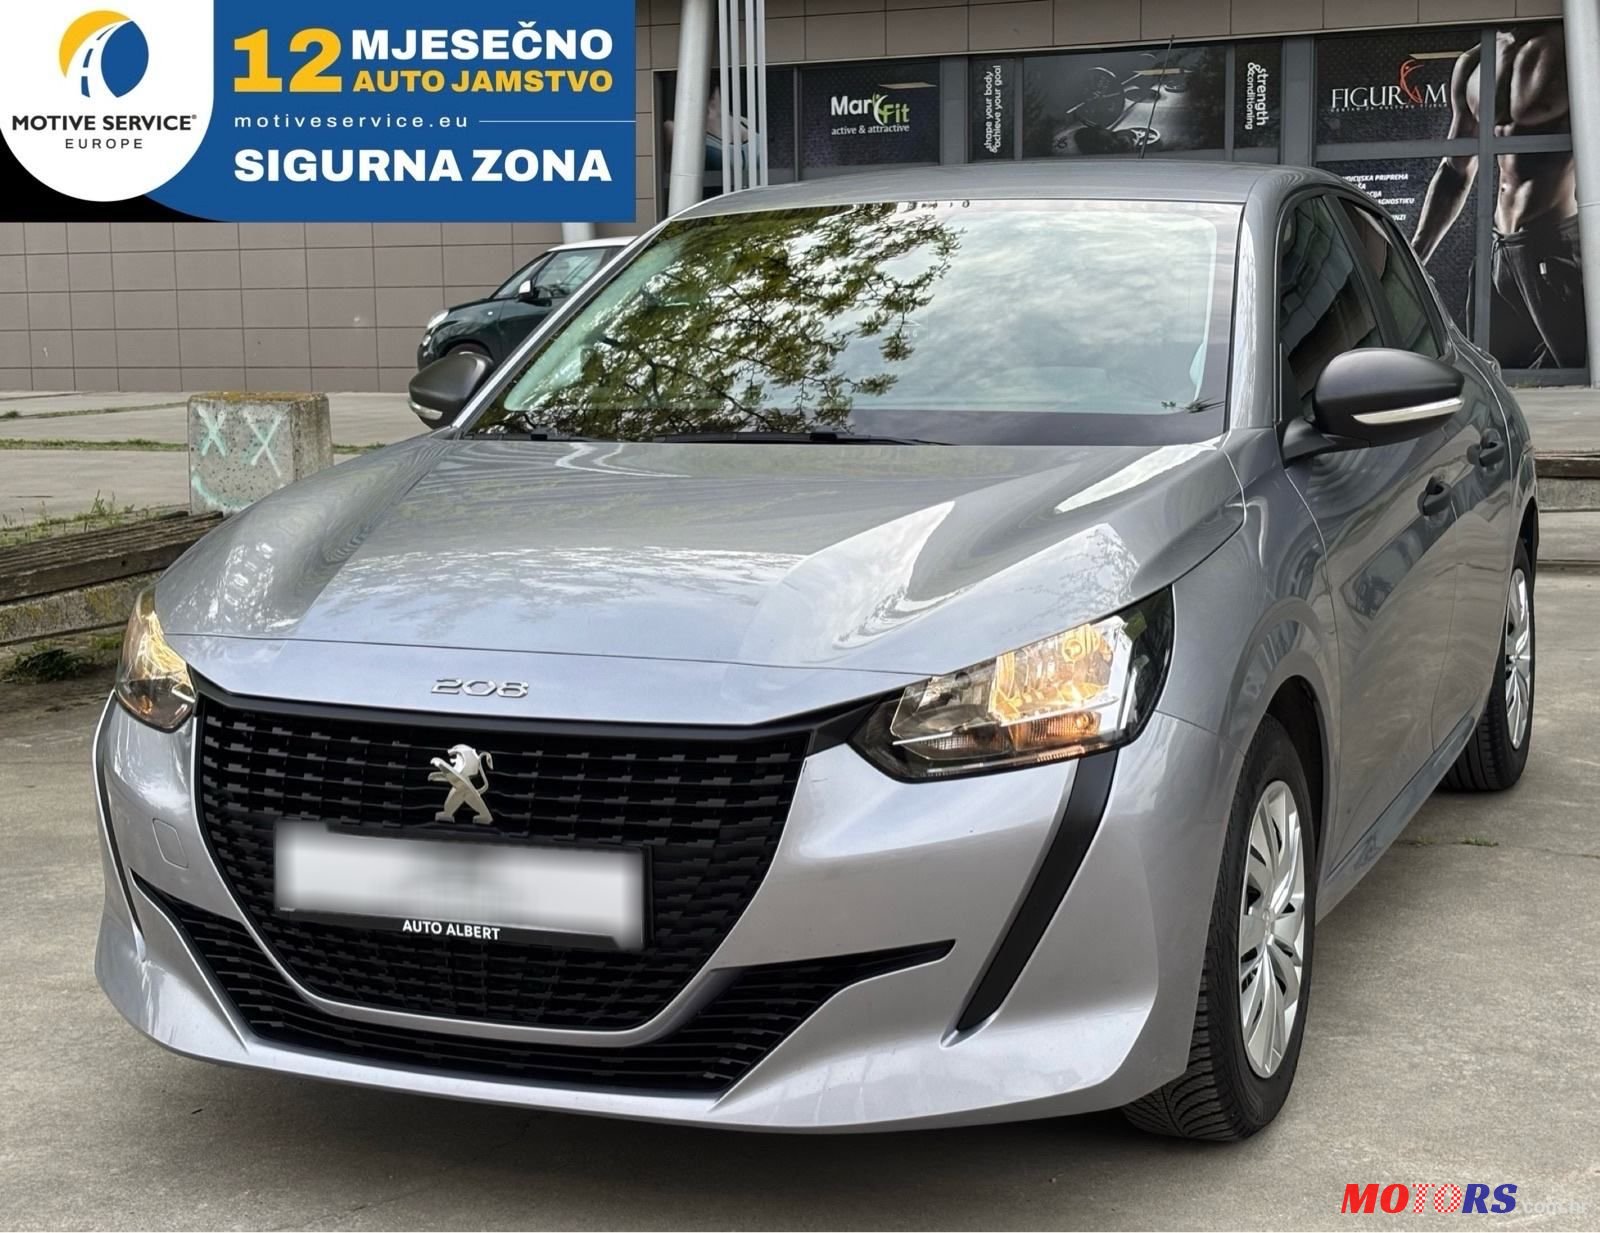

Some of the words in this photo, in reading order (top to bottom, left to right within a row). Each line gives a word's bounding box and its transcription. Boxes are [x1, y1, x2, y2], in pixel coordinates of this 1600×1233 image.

[983, 71, 994, 96] body
[992, 65, 1003, 86] goal
[994, 88, 1003, 110] your
[1254, 68, 1269, 125] strength
[985, 98, 994, 119] your
[831, 126, 857, 135] active
[858, 125, 866, 134] &
[867, 124, 910, 133] attractive
[430, 679, 529, 698] 208
[402, 919, 442, 935] AUTO
[446, 923, 501, 940] ALBERT
